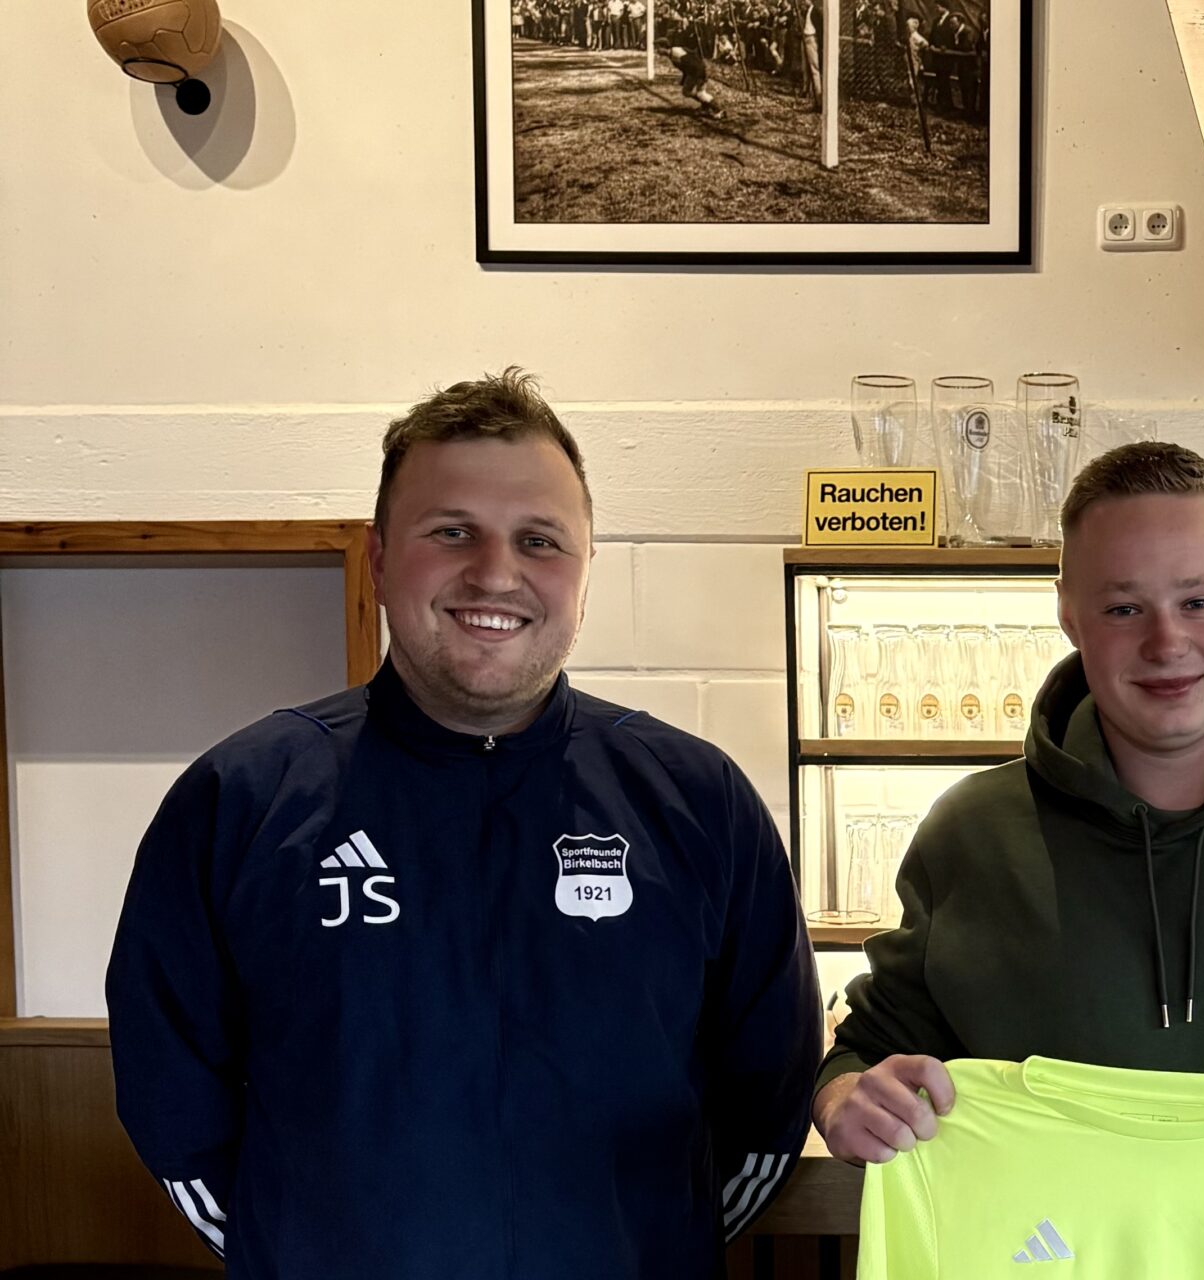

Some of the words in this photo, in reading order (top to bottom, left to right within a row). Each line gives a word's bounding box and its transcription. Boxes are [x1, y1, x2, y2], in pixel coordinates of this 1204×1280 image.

[820, 482, 922, 503] Rauchen
[815, 511, 926, 531] verboten!
[562, 847, 622, 858] Sportfreunde
[563, 858, 621, 869] Birkelbach
[574, 886, 612, 901] 1921
